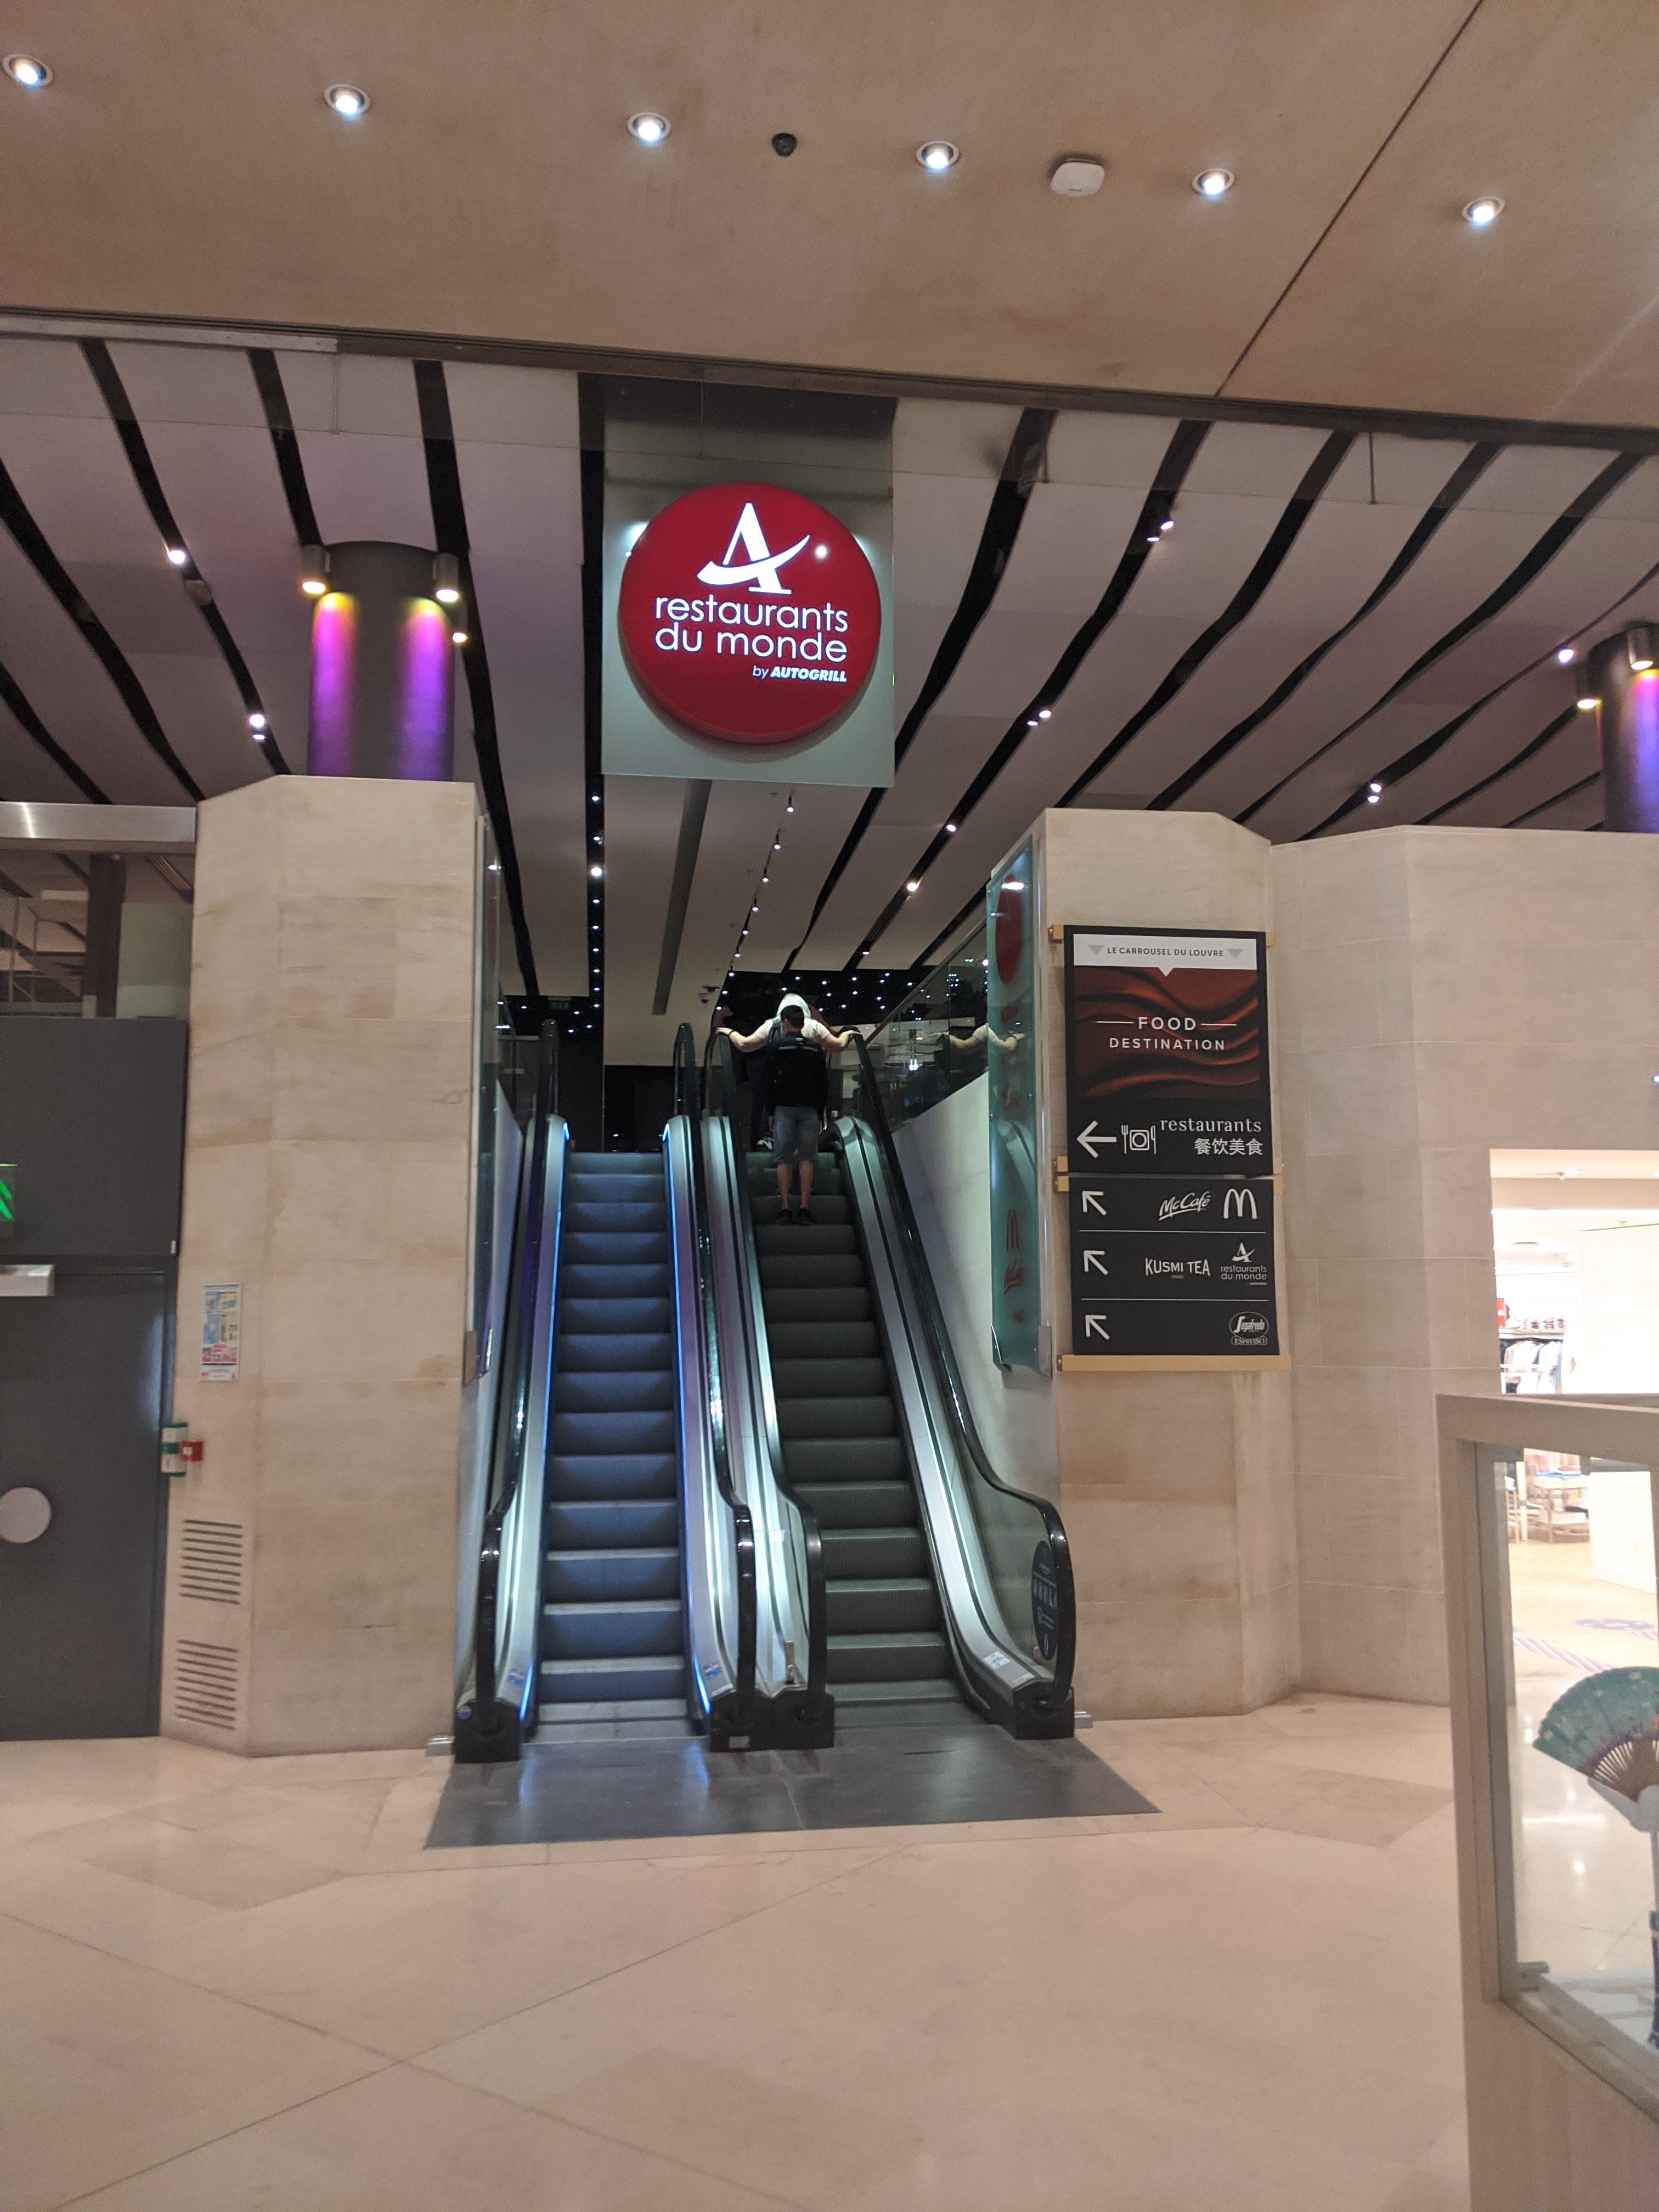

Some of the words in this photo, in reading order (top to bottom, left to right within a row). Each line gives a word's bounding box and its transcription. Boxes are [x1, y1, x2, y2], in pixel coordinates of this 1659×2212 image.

[654, 594, 848, 633] restaurants
[654, 622, 703, 653] du
[716, 631, 848, 662] monde
[753, 665, 769, 680] by
[770, 666, 847, 682] AUTOGRILL
[1119, 947, 1171, 956] CARROUSEL
[1138, 1017, 1197, 1031] FOOD
[1109, 1037, 1224, 1050] DESTINATION
[1160, 1118, 1262, 1132] restaurants
[1194, 1138, 1263, 1155] 餐饮美食
[1159, 1191, 1211, 1219] McCafé
[1145, 1257, 1183, 1276] KUSMI
[1187, 1259, 1211, 1276] TEA
[1221, 1265, 1267, 1273] restaurants
